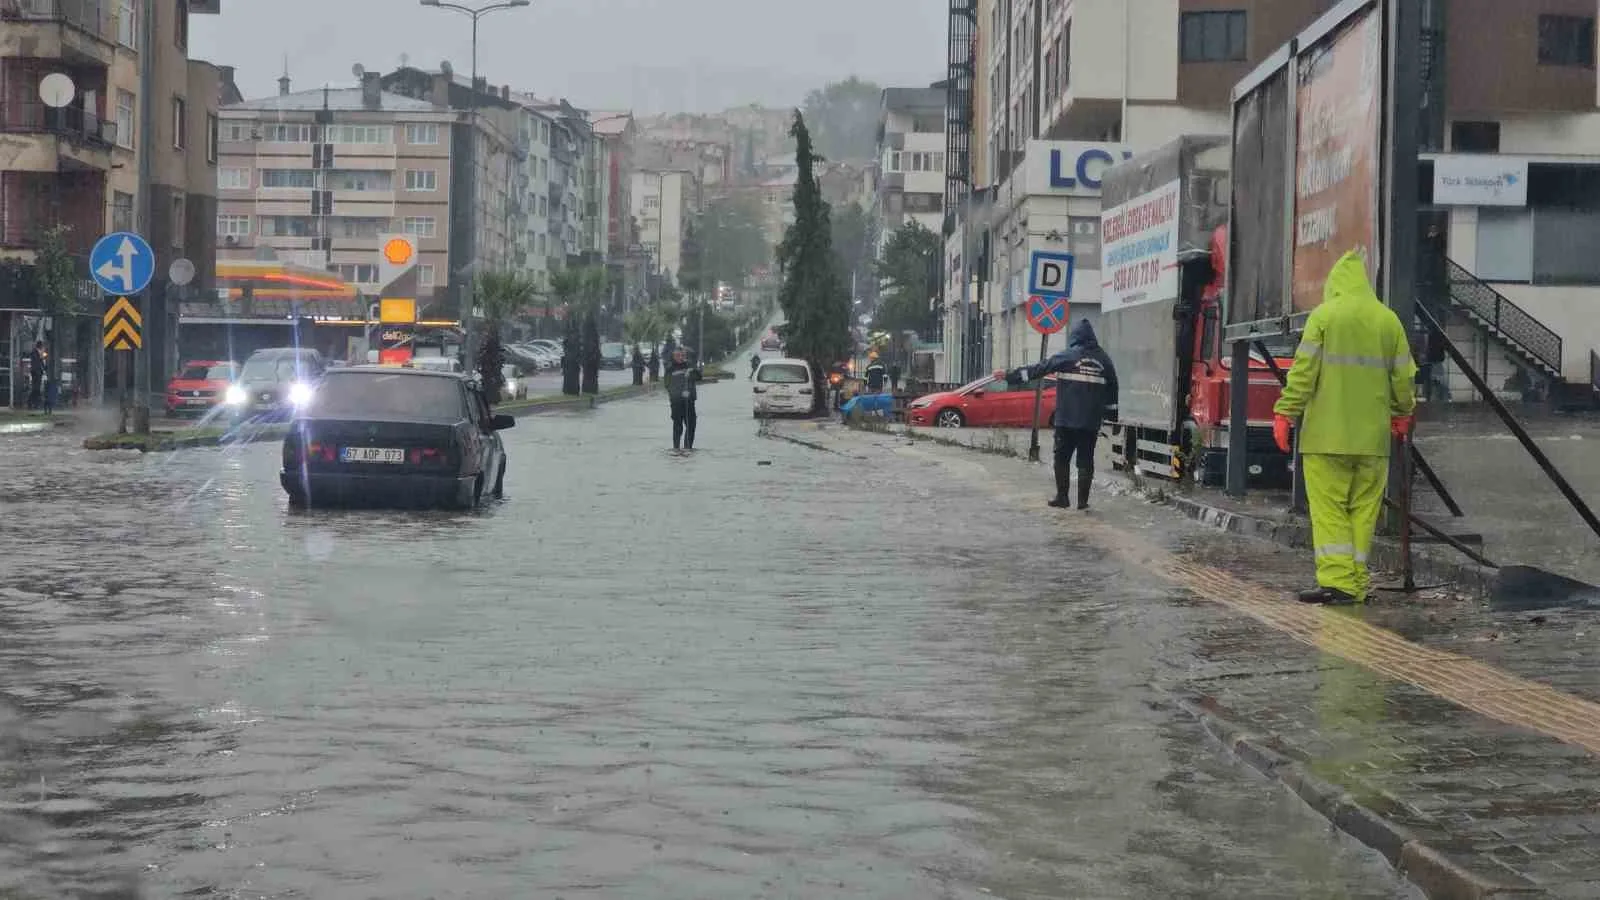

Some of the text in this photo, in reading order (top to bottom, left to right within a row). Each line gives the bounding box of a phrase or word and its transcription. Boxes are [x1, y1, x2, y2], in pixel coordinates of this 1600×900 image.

[1050, 148, 1114, 190] LC
[1441, 175, 1461, 185] Türk
[1042, 262, 1061, 287] D
[346, 448, 358, 459] 67
